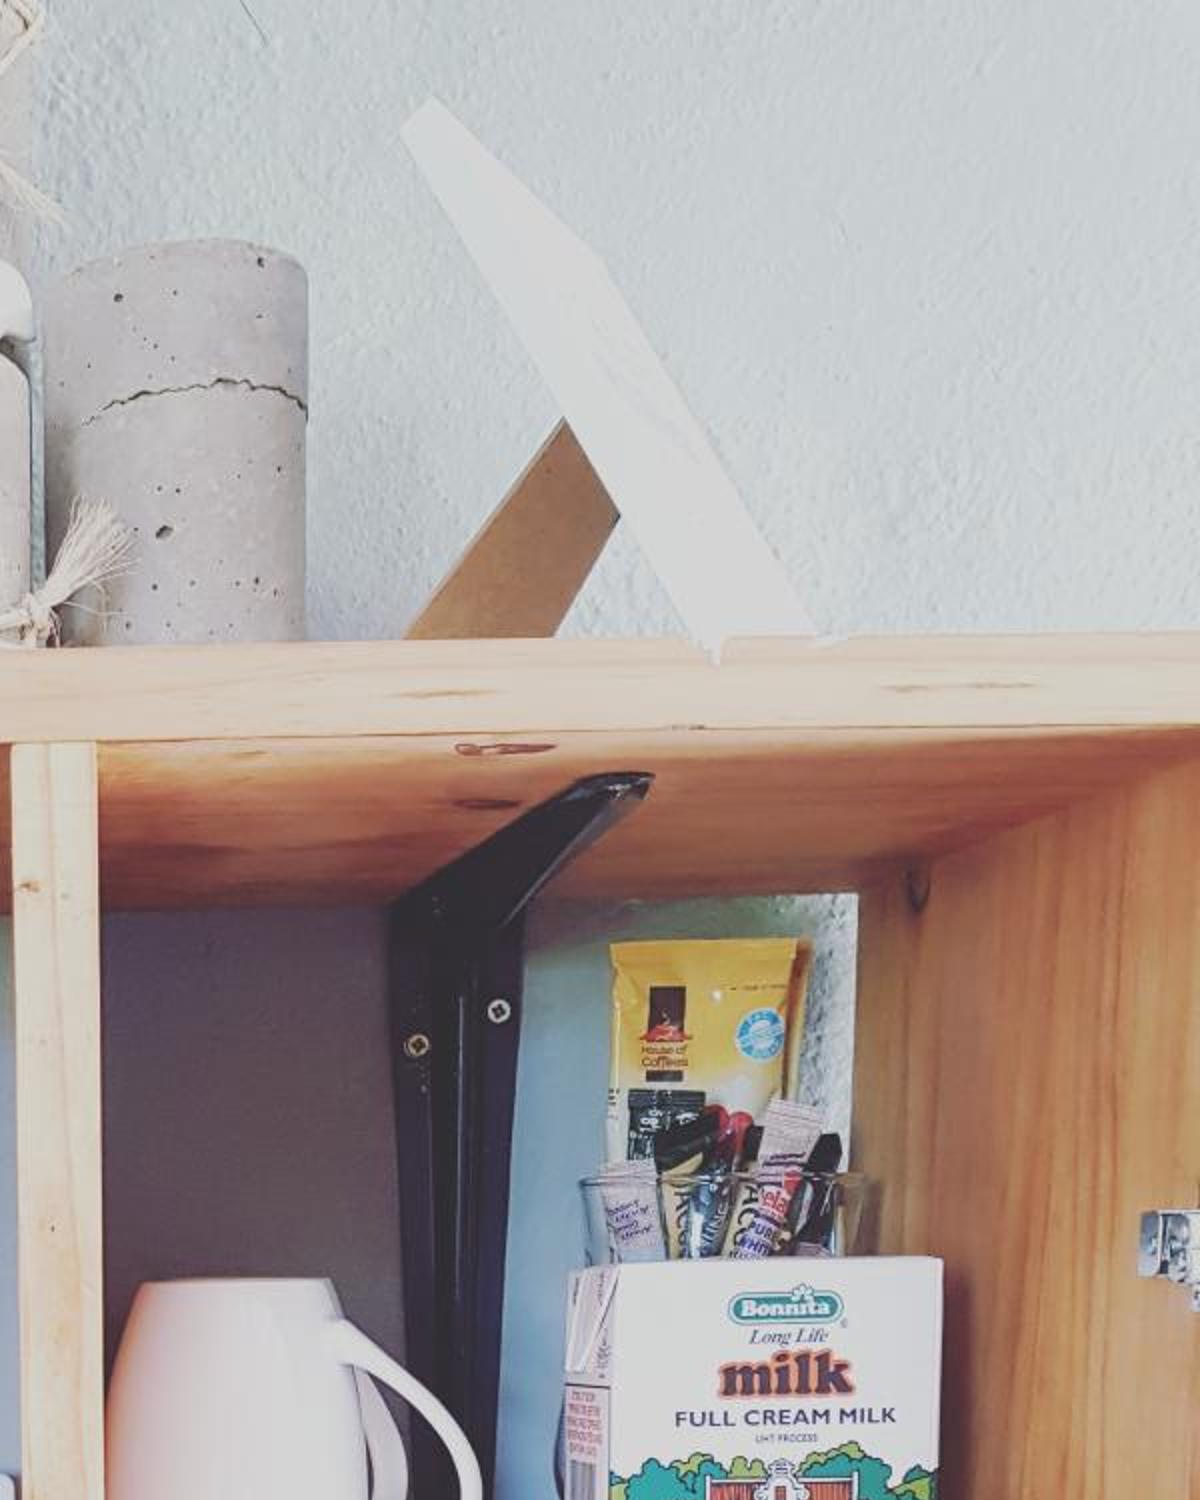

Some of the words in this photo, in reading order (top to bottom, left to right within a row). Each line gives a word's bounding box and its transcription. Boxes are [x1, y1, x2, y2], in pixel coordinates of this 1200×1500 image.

[740, 1296, 830, 1318] Bonnita
[749, 1329, 791, 1346] Long
[796, 1327, 829, 1344] Life
[719, 1349, 854, 1397] milk
[675, 1410, 736, 1428] FULL
[744, 1408, 831, 1426] CREAM
[839, 1407, 897, 1425] MILK
[778, 1433, 818, 1443] PROCESS
